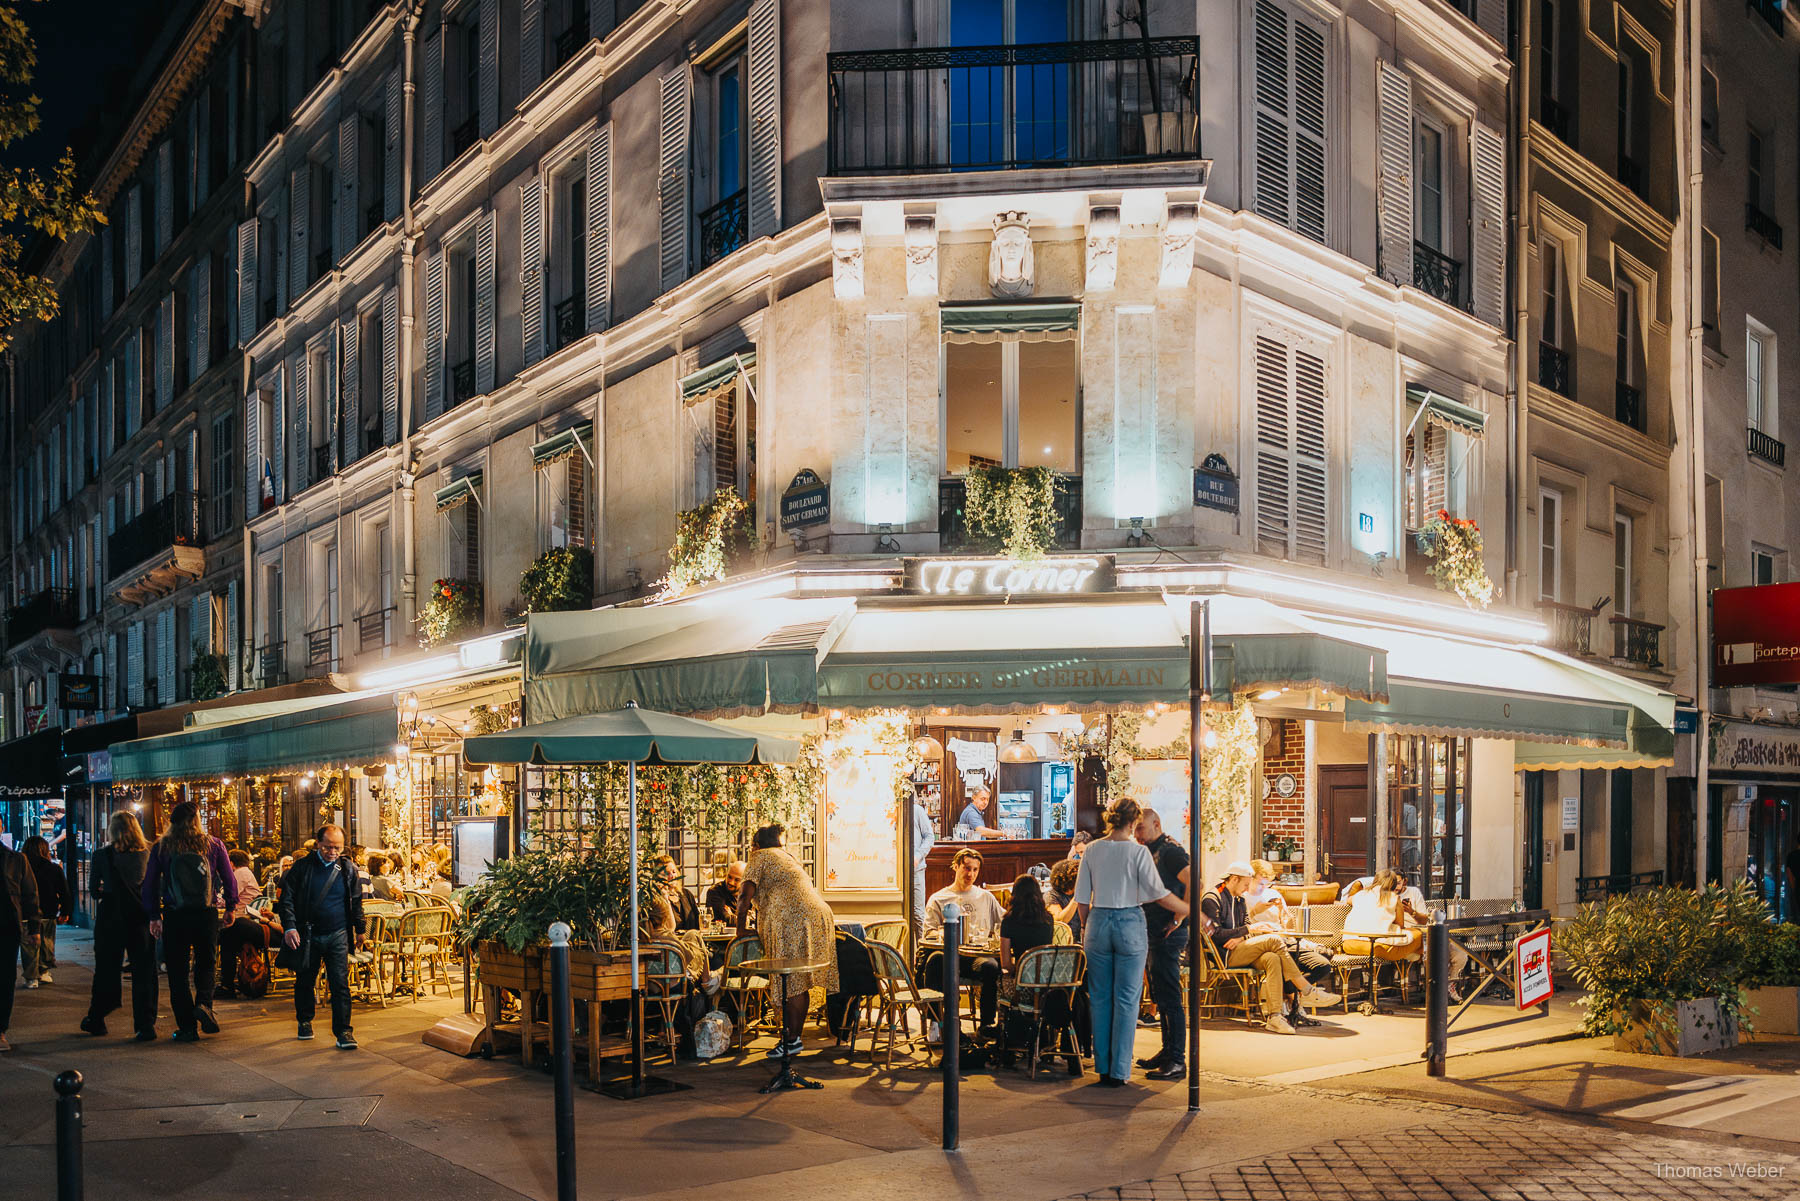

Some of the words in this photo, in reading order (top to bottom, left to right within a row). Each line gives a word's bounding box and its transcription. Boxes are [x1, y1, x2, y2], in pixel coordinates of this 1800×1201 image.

[1210, 480, 1225, 492] RUE
[788, 495, 822, 511] BOULEVARD
[1198, 489, 1238, 507] BOUTEBRIE
[782, 512, 801, 525] SAINT
[801, 506, 828, 520] GERMAIN
[1362, 515, 1372, 532] 18
[936, 564, 974, 593] Le
[985, 565, 1095, 592] Corner
[1755, 646, 1800, 661] porte-p
[867, 670, 983, 691] CORNER
[991, 669, 1022, 689] ST
[1032, 667, 1165, 688] GERMAIN
[1503, 703, 1511, 718] C
